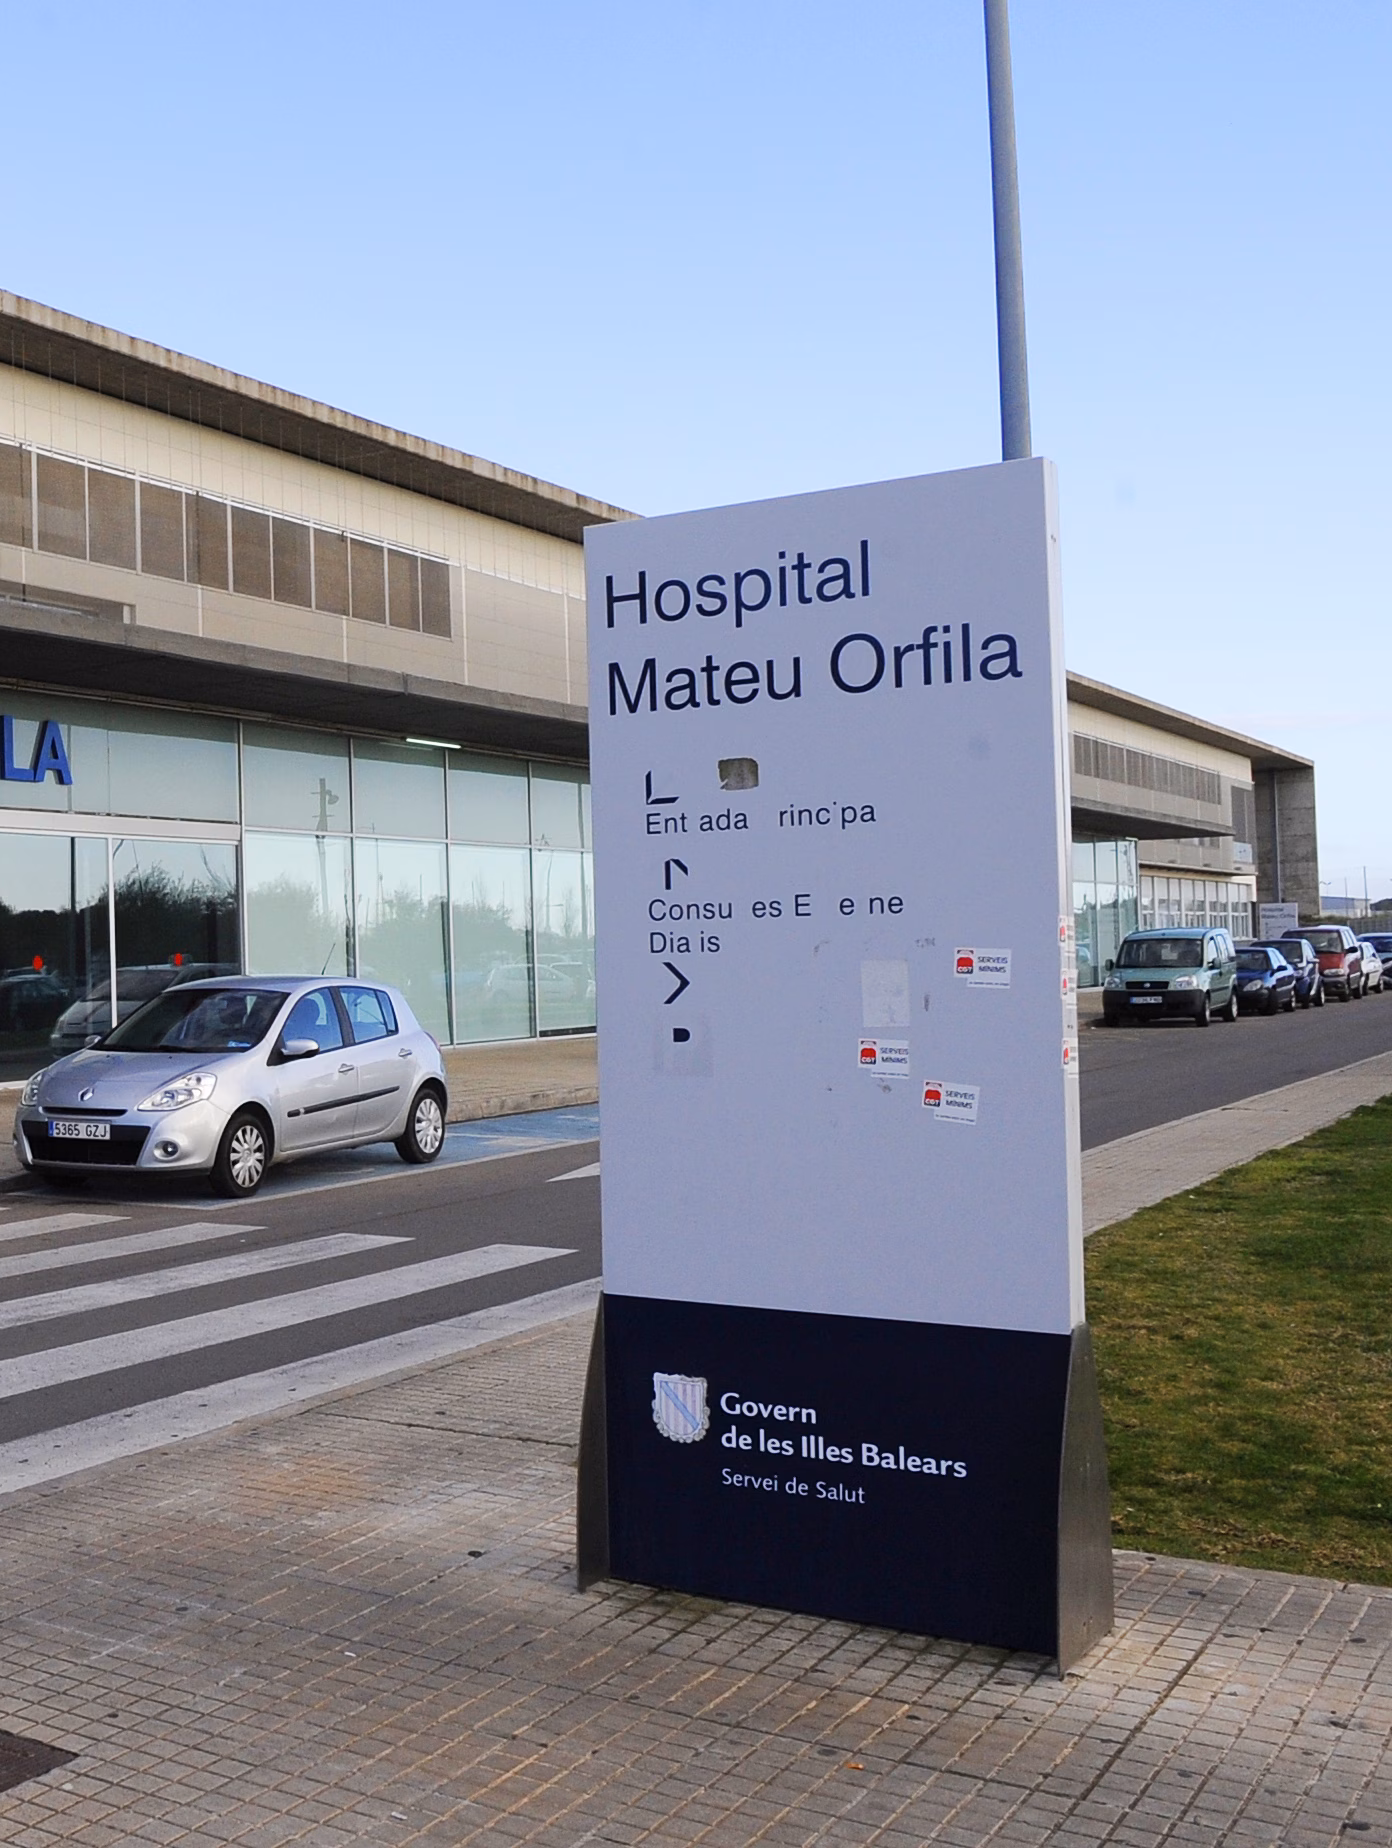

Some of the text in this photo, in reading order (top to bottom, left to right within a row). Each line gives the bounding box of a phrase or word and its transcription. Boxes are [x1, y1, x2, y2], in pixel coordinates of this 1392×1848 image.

[605, 539, 871, 629] Hospital
[607, 622, 1024, 716] Mateu Orfila
[54, 1122, 107, 1138] 5365 GZJ
[720, 1392, 817, 1424] Govern
[720, 1425, 968, 1478] de les Illes Balears
[721, 1468, 866, 1504] Servei de Salut
